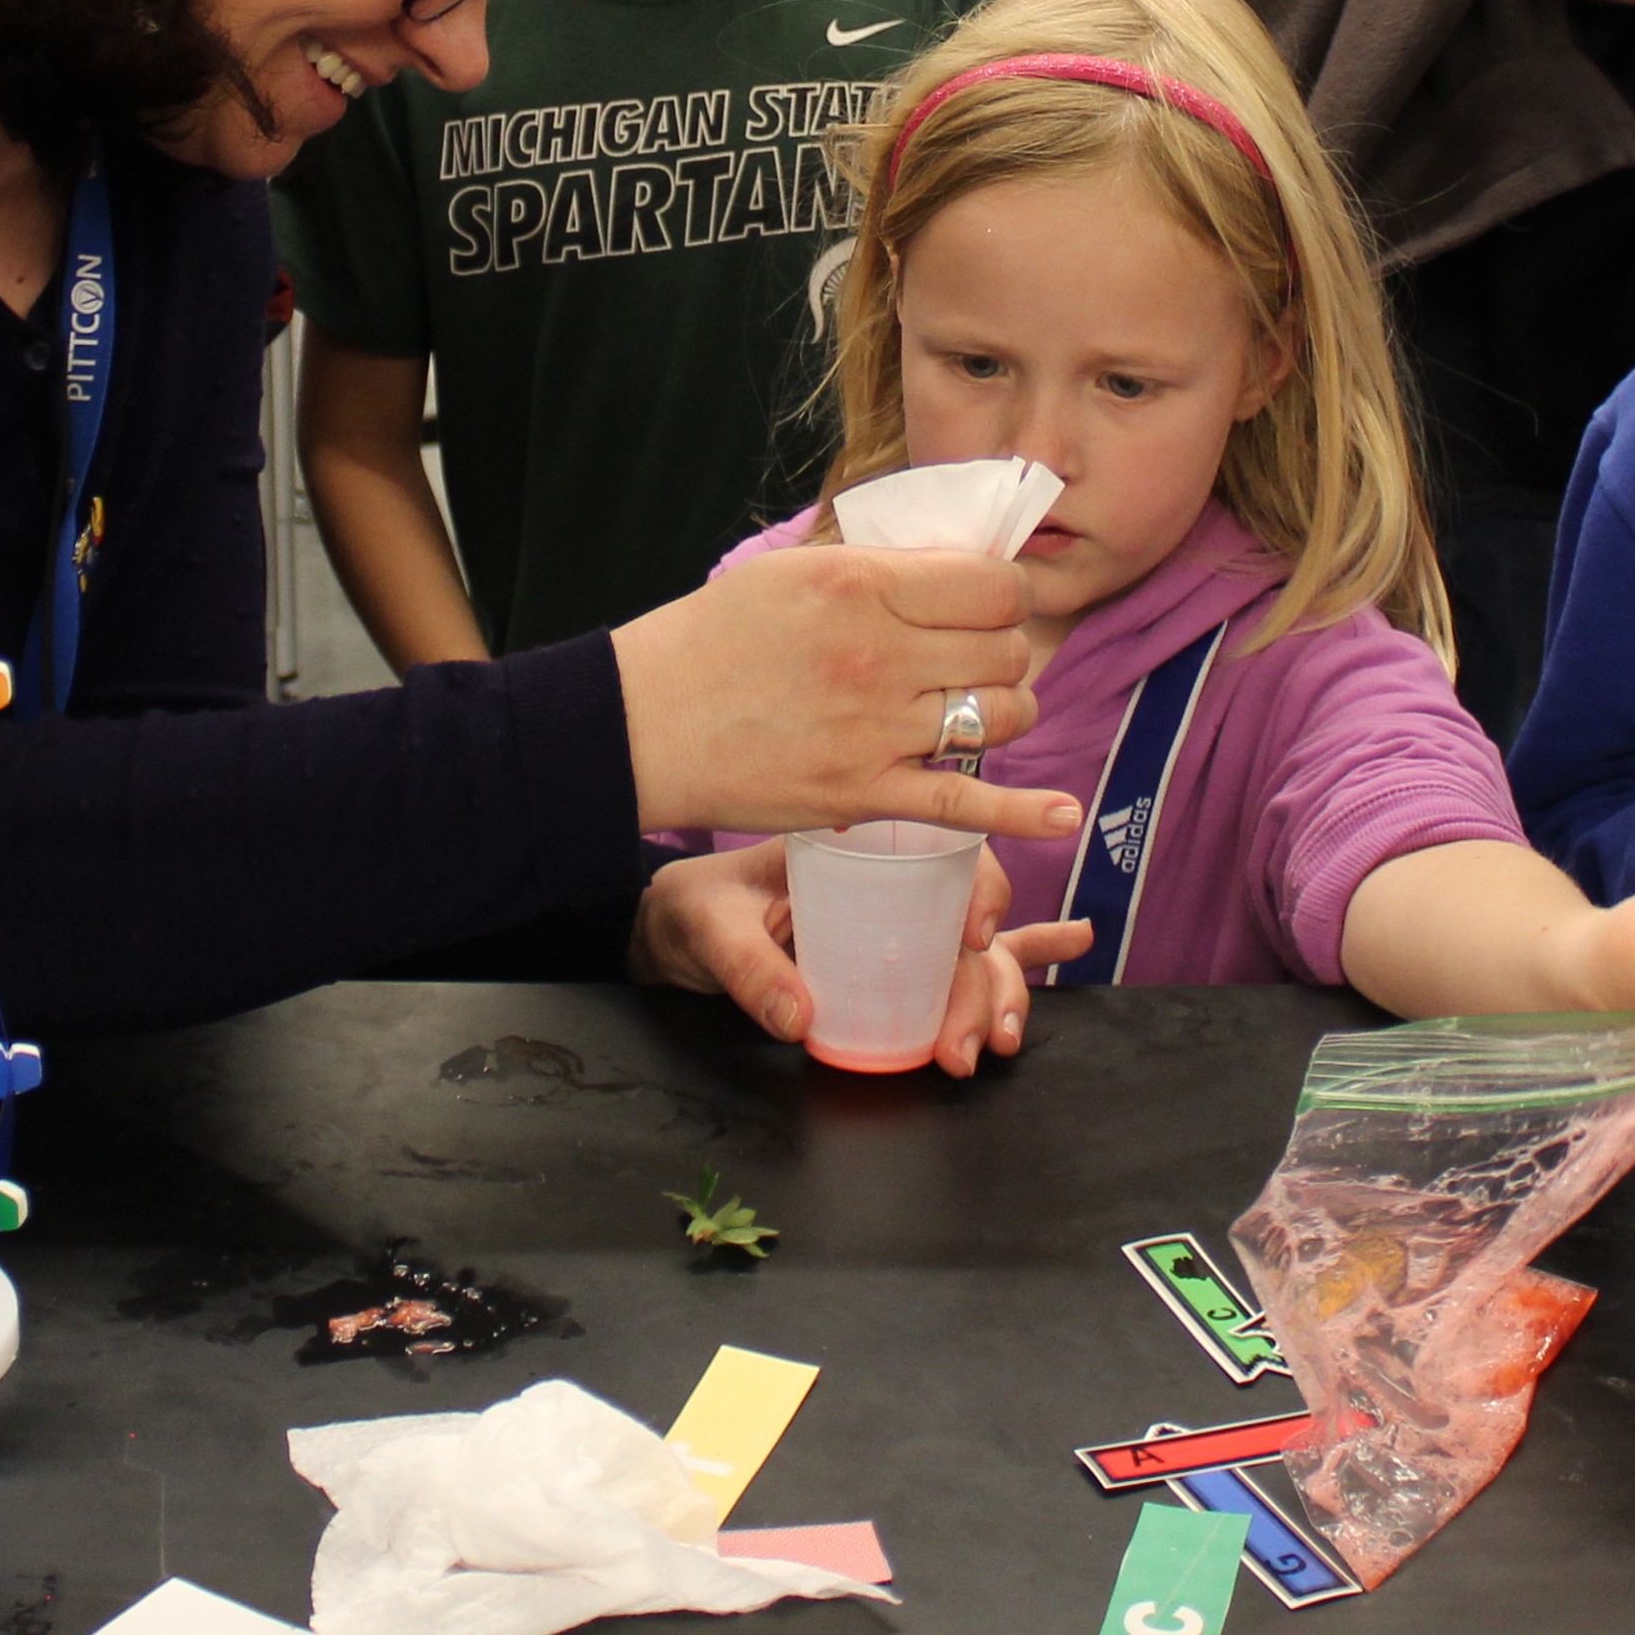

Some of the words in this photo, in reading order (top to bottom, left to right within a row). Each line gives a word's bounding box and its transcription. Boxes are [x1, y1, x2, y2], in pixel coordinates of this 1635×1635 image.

[440, 89, 730, 180] MICHIGAN
[1121, 796, 1152, 873] adidas
[1130, 1447, 1164, 1467] A
[1263, 1554, 1307, 1576] G
